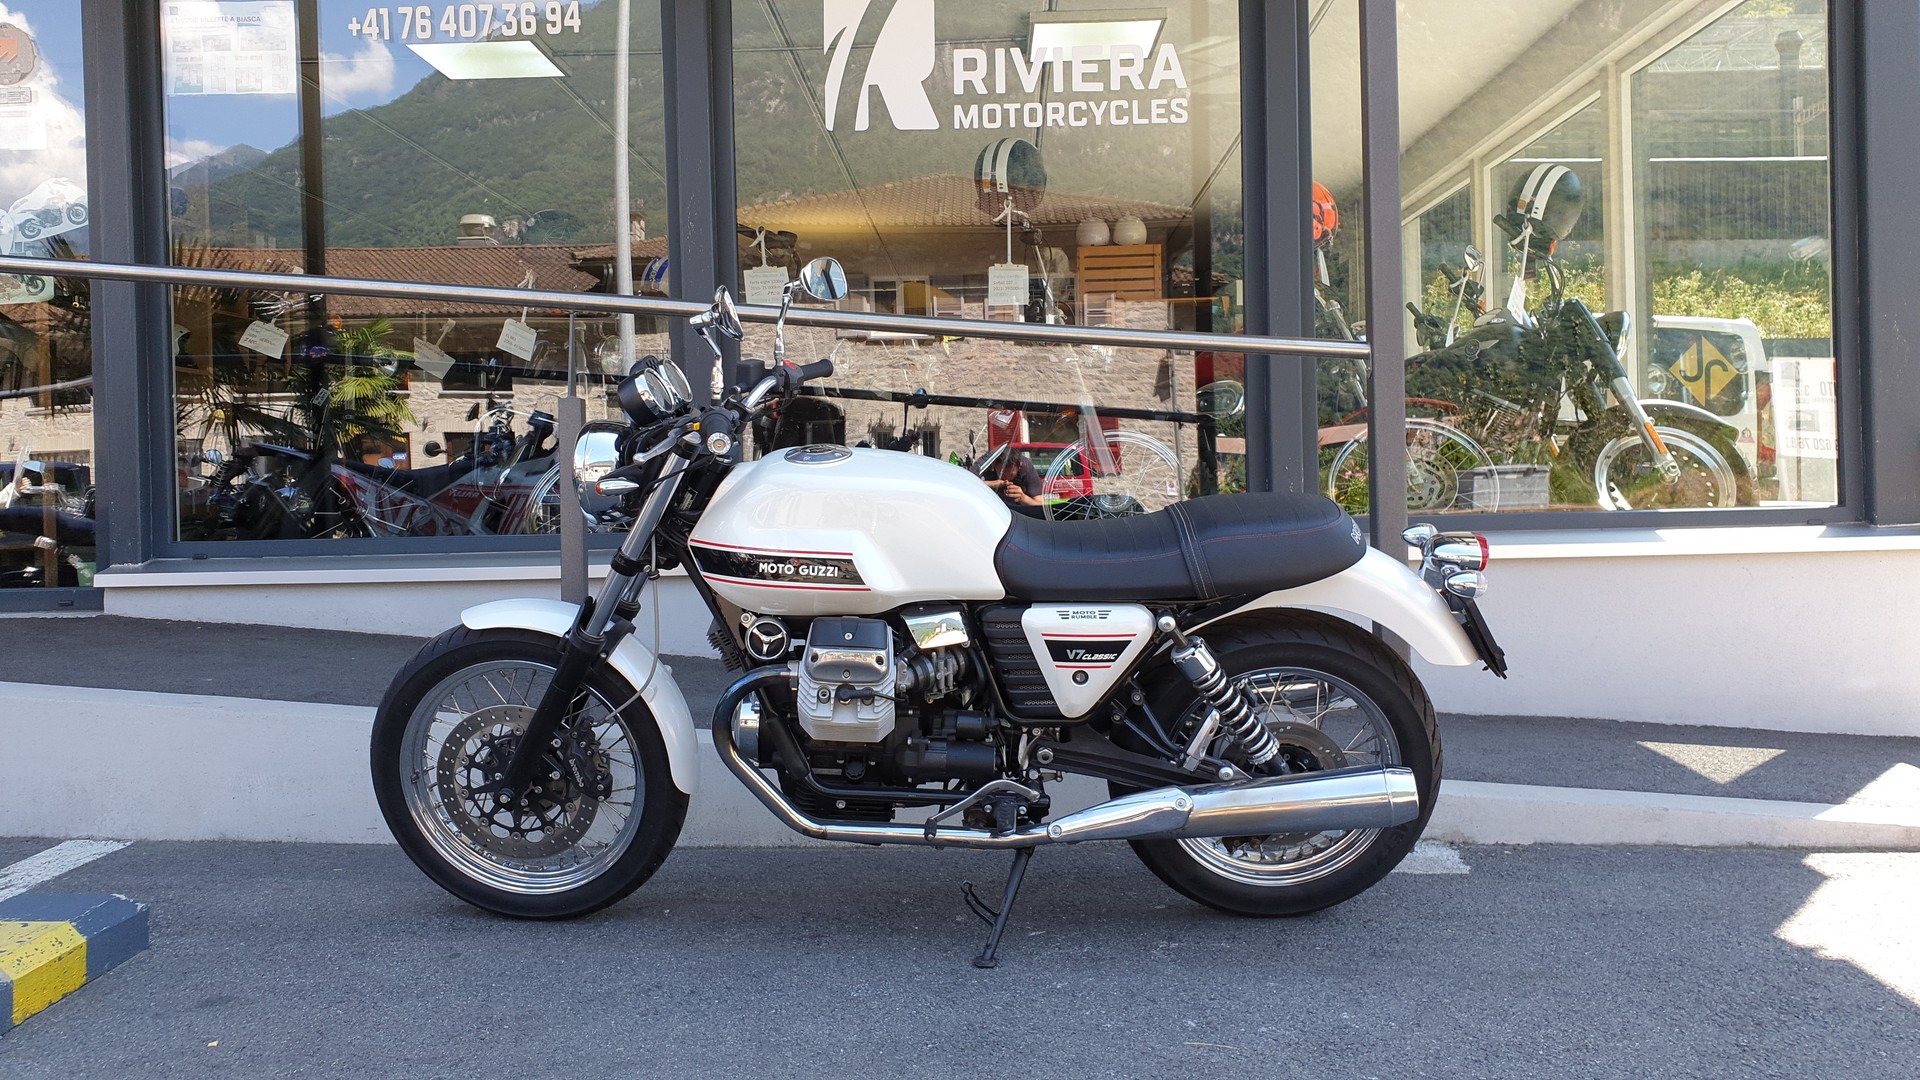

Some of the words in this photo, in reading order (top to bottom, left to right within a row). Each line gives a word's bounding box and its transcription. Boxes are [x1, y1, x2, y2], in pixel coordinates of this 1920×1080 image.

[348, 8, 390, 41] +41
[398, 5, 432, 39] 76
[440, 4, 493, 38] 407
[501, 2, 537, 36] 36
[545, 0, 581, 34] 94
[953, 43, 1188, 95] RIVIERA
[953, 99, 1189, 130] MOTORCYCLES
[759, 562, 795, 575] MOTO
[798, 565, 839, 577] GUZZI
[1066, 649, 1086, 660] V7
[568, 758, 585, 788] brembo
